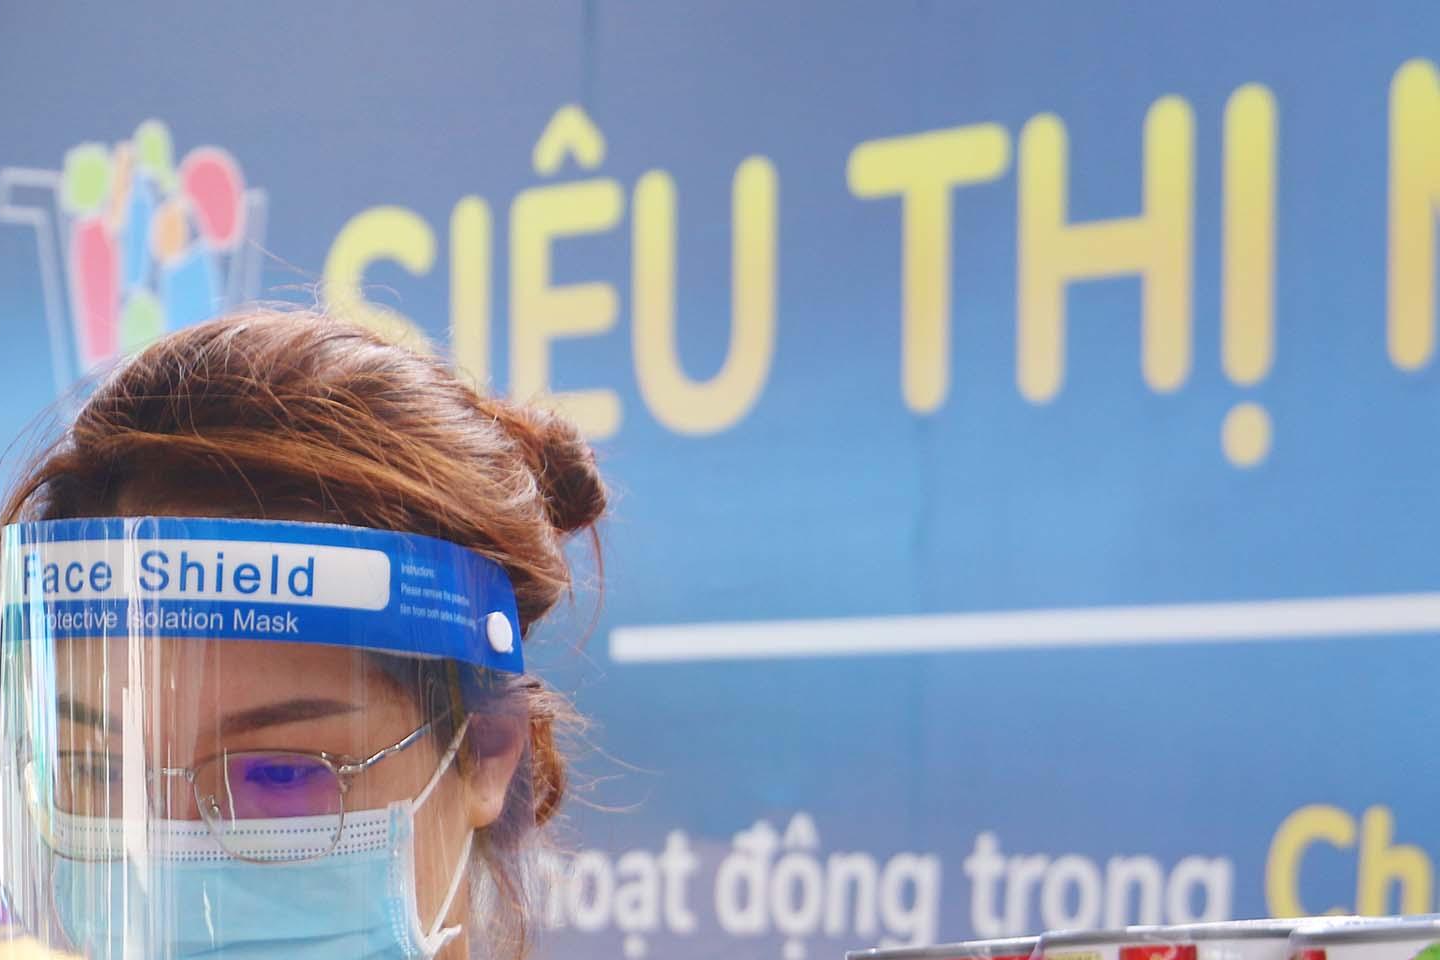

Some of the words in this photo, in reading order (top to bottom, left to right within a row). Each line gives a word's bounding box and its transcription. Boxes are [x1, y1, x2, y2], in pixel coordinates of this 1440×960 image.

[323, 104, 779, 440] SIÊU
[846, 82, 1278, 468] THỊ
[24, 551, 113, 594] Face
[139, 549, 315, 597] Shield
[34, 606, 118, 630] otective
[127, 606, 223, 631] Isolation
[233, 607, 299, 633] Mask
[1264, 803, 1433, 920] Ch
